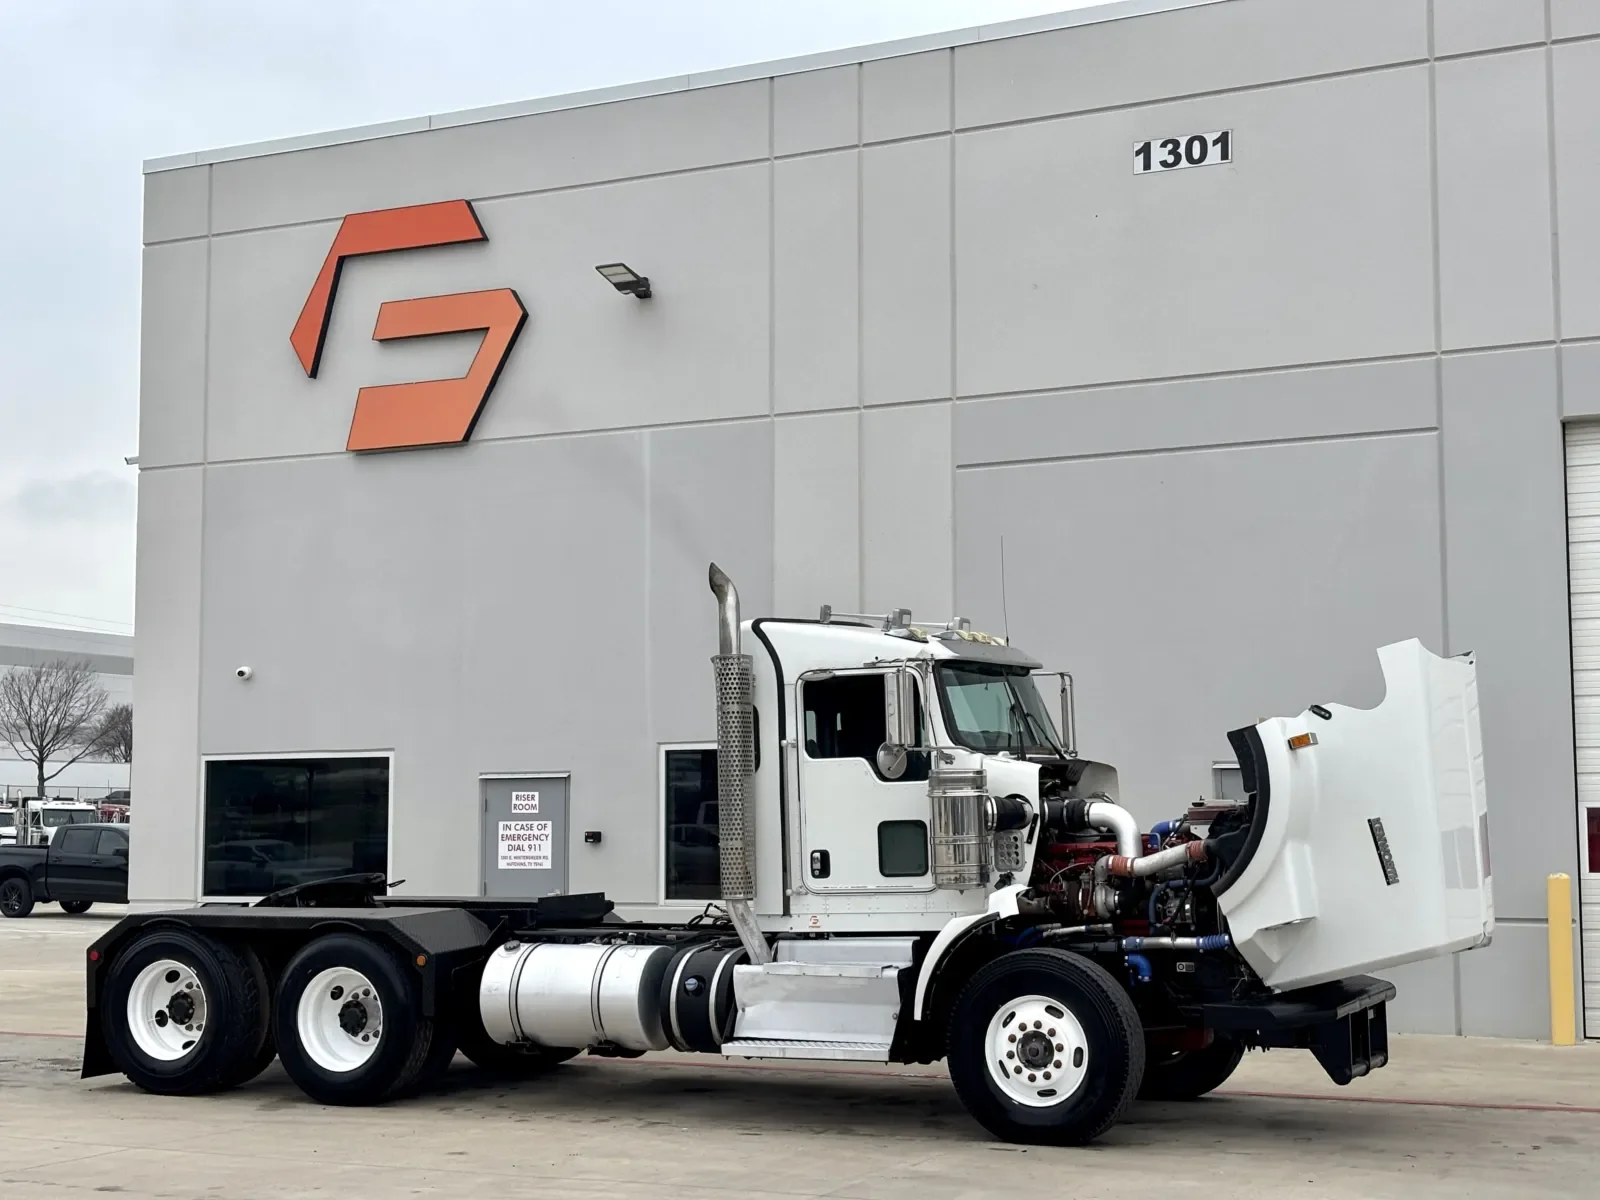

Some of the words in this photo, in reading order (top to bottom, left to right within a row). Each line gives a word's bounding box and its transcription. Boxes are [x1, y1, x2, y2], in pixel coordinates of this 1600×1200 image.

[1135, 131, 1229, 171] 1301
[513, 803, 537, 811] ROOM
[502, 823, 512, 831] IN
[514, 823, 534, 831] CASE
[536, 823, 548, 831] OF
[500, 833, 549, 841] EMERGENCY
[1369, 817, 1400, 885] KENWORTH
